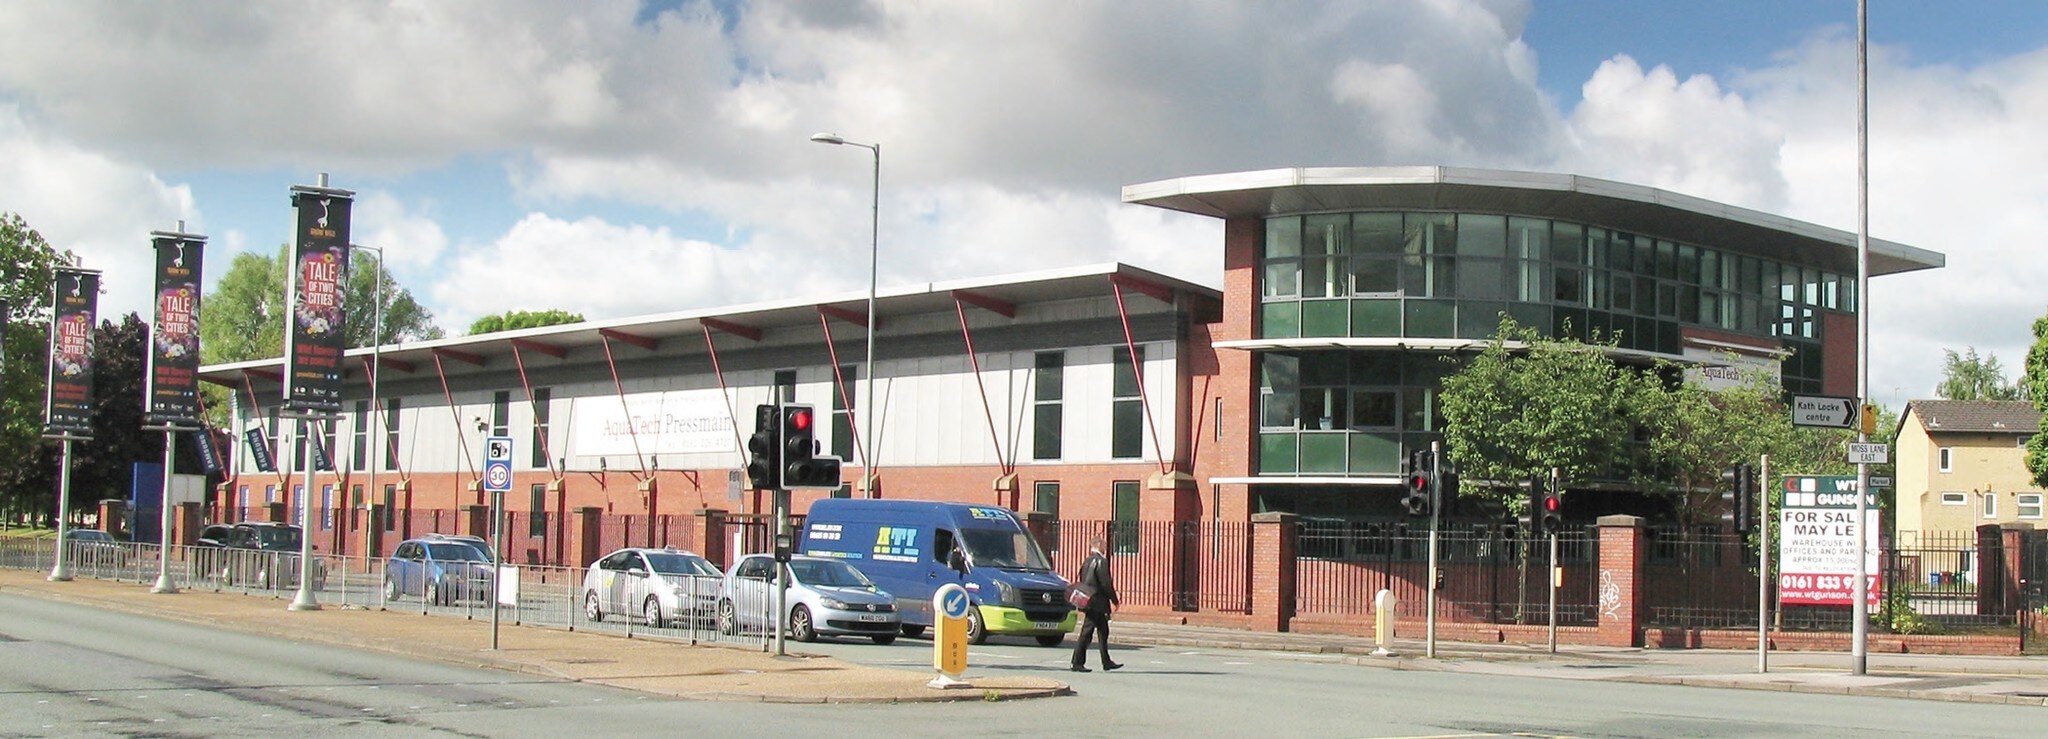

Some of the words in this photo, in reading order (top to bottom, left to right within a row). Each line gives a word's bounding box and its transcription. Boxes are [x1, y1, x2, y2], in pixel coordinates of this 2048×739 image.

[308, 261, 335, 282] TALE
[308, 282, 317, 292] OF
[318, 282, 334, 293] TWO
[166, 295, 190, 312] TALE
[308, 293, 333, 306] CITIES
[166, 312, 174, 321] OF
[175, 313, 189, 323] TWO
[64, 321, 86, 337] TALE
[166, 322, 188, 334] CITIES
[64, 335, 73, 345] OF
[73, 336, 85, 346] TWO
[64, 344, 85, 355] CITIES
[1797, 401, 1815, 410] Kath
[1818, 402, 1840, 411] Locke
[1806, 412, 1831, 422] centre
[603, 413, 661, 442] AquaTech
[665, 411, 732, 434] Pressmain
[199, 434, 215, 470] SAMSUNG
[251, 432, 268, 468] SAMSUNG
[1851, 444, 1868, 453] MOSS
[1870, 445, 1885, 454] LANE
[1860, 453, 1876, 462] EAST
[490, 471, 505, 481] 30
[1835, 479, 1857, 491] WT
[1817, 493, 1875, 506] GUNSN
[1785, 511, 1817, 523] FOR
[1824, 511, 1855, 523] SAL
[1794, 524, 1828, 535] MAY
[1835, 525, 1854, 536] LE
[1792, 539, 1843, 547] WAREHOUSE
[1783, 547, 1817, 555] OFFICES
[1820, 547, 1837, 555] AND
[1840, 548, 1876, 556] PARNG
[1782, 575, 1812, 589] 0161
[1816, 575, 1841, 590] 833
